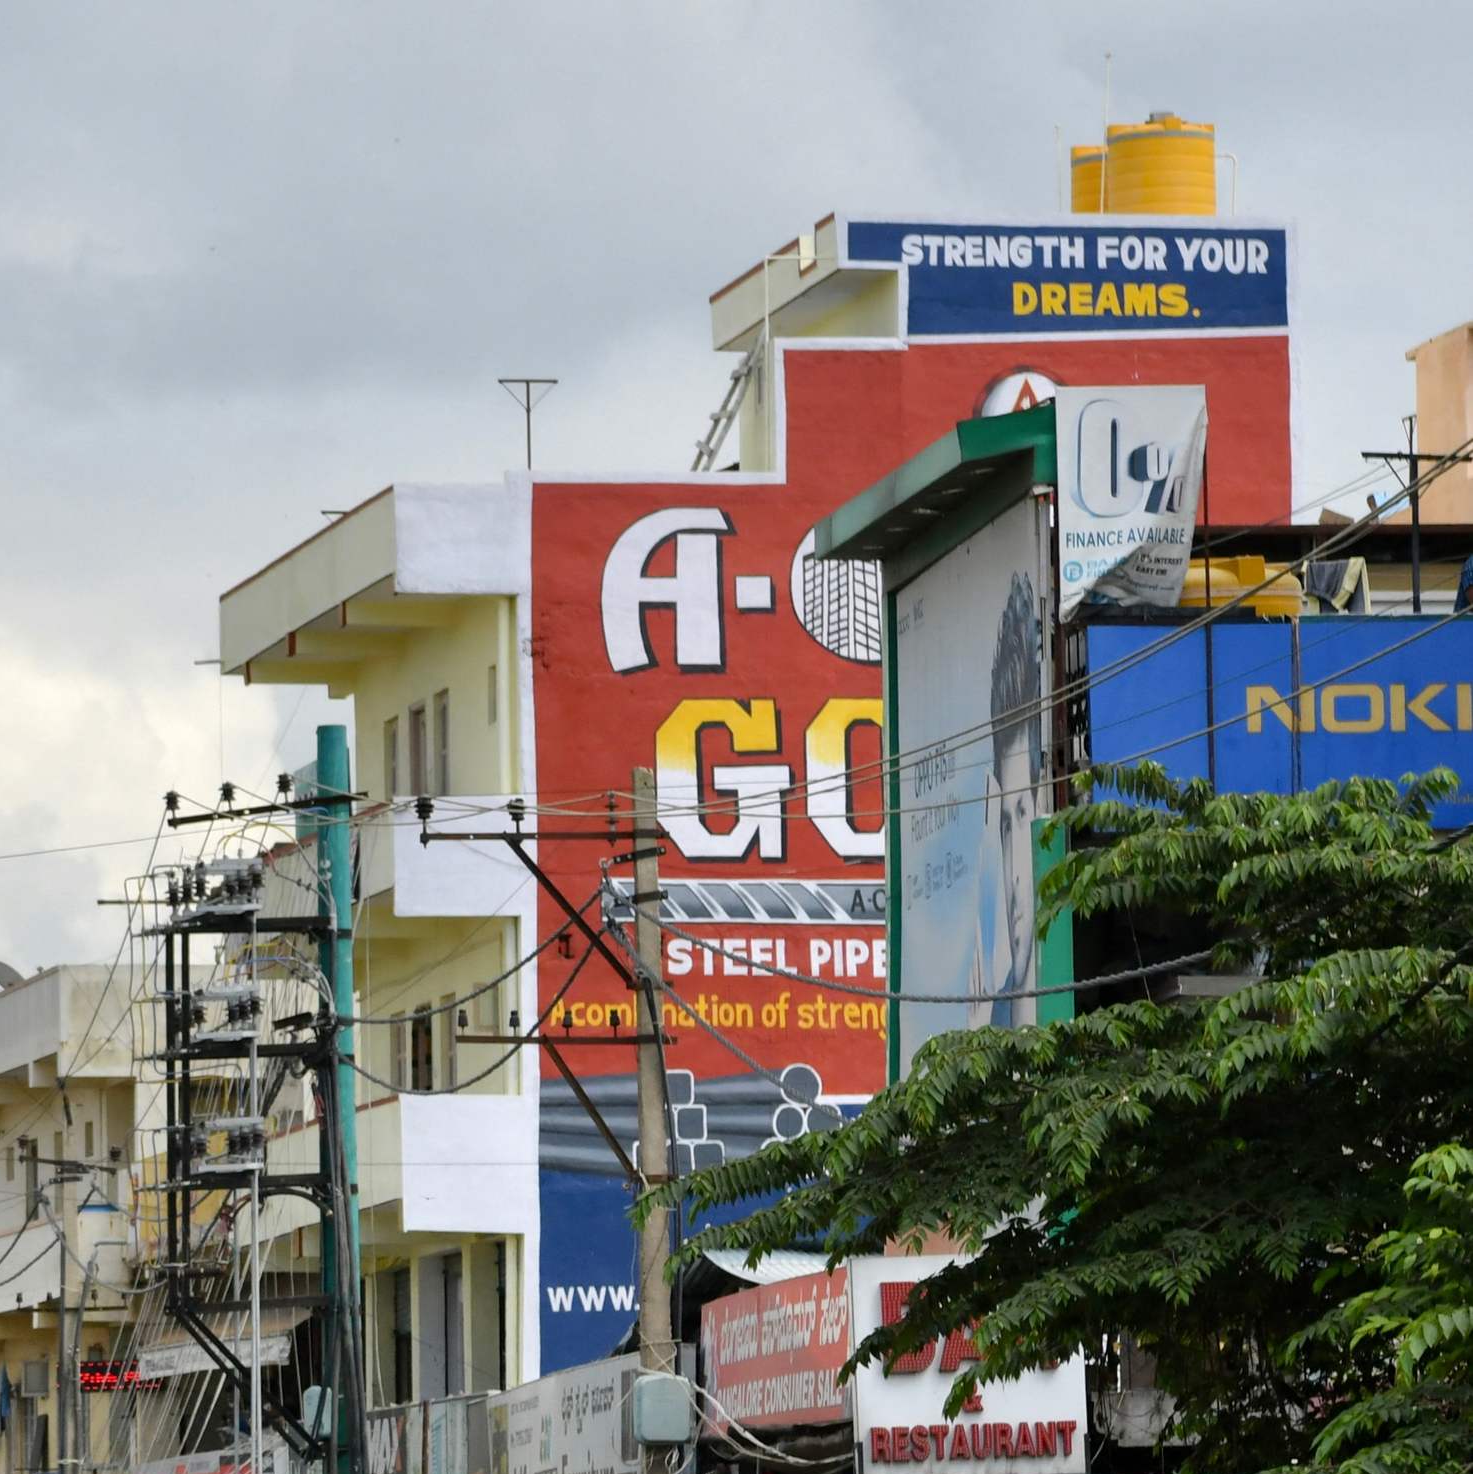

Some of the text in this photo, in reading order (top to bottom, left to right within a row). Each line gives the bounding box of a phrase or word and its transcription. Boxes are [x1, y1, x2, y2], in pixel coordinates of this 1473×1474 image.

[901, 234, 1269, 274] STRENGTH FOR YOUR
[1012, 281, 1201, 318] DREAMS.
[1065, 526, 1185, 549] FINANCE AVAILABLE
[1246, 684, 1473, 733] NOKI
[666, 937, 799, 977] STEEL
[761, 991, 792, 1028] of
[547, 1285, 641, 1312] www.
[765, 1370, 815, 1414] CONSUMER
[870, 1420, 1078, 1464] RESTAURANT
